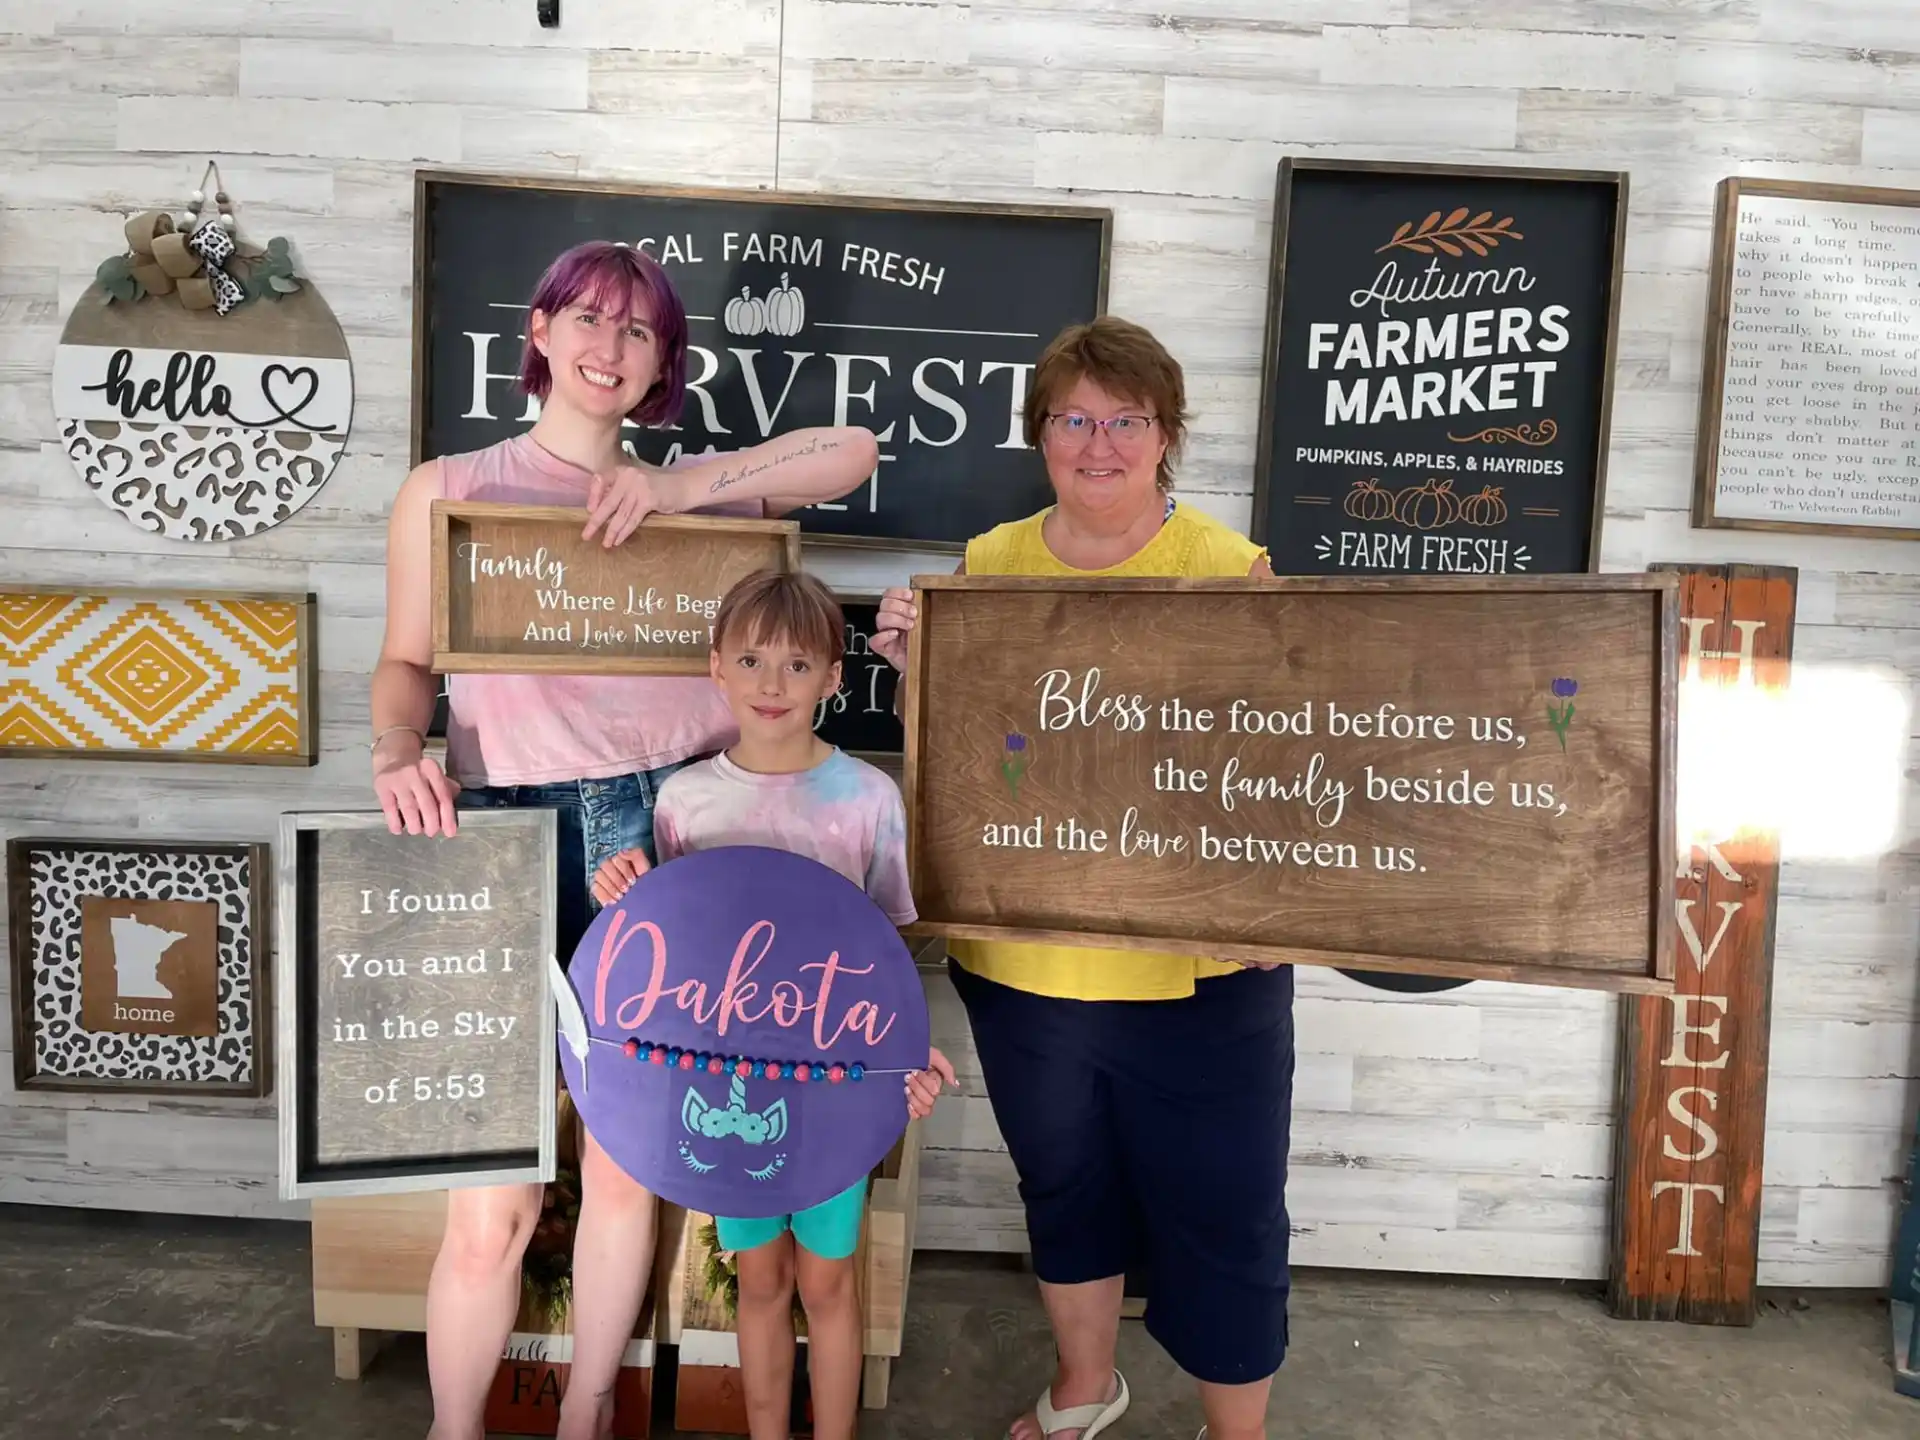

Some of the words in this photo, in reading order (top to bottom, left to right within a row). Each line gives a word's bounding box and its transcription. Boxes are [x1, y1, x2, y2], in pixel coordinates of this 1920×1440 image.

[1741, 212, 1762, 224] He
[1739, 231, 1781, 244] takes
[1815, 235, 1847, 249] long
[1858, 240, 1896, 251] time.
[614, 233, 702, 264] CAL
[723, 233, 822, 267] FARM
[842, 244, 945, 295] FRESH
[1738, 250, 1770, 263] why
[1780, 252, 1791, 262] it
[1863, 254, 1917, 271] happen
[1350, 257, 1536, 317] Autumn
[1737, 267, 1751, 277] to
[1763, 270, 1812, 283] people
[1823, 272, 1854, 284] who
[1865, 274, 1907, 288] break
[1735, 287, 1751, 296] or
[1760, 286, 1796, 297] have
[1804, 289, 1848, 304] sharp
[1734, 304, 1771, 315] have
[1785, 307, 1800, 317] to
[1814, 308, 1831, 319] be
[1845, 310, 1911, 324] carefully
[1308, 305, 1571, 370] FARMERS
[1823, 327, 1841, 338] by
[1852, 328, 1876, 340] the
[1731, 341, 1758, 351] you
[1767, 343, 1793, 352] are
[1861, 347, 1897, 358] most
[1904, 348, 1920, 360] of
[1730, 356, 1763, 368] hair
[1781, 359, 1808, 371] has
[1826, 362, 1861, 374] been
[1880, 364, 1917, 378] loved
[81, 348, 233, 422] hello
[461, 331, 1036, 450] HRVEST
[1324, 361, 1557, 426] MARKET
[1728, 375, 1757, 386] and
[1766, 379, 1802, 390] your
[1811, 382, 1844, 392] eyes
[1854, 381, 1888, 396] drop
[1727, 395, 1754, 405] you
[1766, 396, 1791, 406] get
[1803, 396, 1841, 408] loose
[1852, 399, 1867, 410] in
[1879, 400, 1902, 412] the
[1725, 411, 1754, 422] and
[1764, 414, 1797, 425] very
[1880, 418, 1907, 430] But
[1724, 428, 1772, 442] things
[1786, 431, 1824, 444] don't
[1837, 436, 1889, 447] matter
[1901, 439, 1915, 449] at
[1296, 448, 1387, 468] PUMPKINS,
[1392, 452, 1460, 471] APPLES,
[1466, 456, 1477, 471] &
[1483, 457, 1564, 475] HAYRIDES
[1722, 446, 1784, 459] because
[1792, 452, 1827, 462] once
[1836, 454, 1863, 465] you
[1872, 456, 1897, 466] are
[1719, 466, 1748, 477] you
[1758, 466, 1796, 478] can't
[1805, 468, 1823, 480] be
[1878, 475, 1919, 488] excep
[1719, 483, 1770, 496] people
[1773, 484, 1804, 497] who
[1808, 485, 1844, 499] don't
[1769, 500, 1794, 511] The
[1799, 501, 1858, 515] Velveteen
[1862, 504, 1901, 517] Rabbit
[457, 542, 568, 589] Family
[1338, 531, 1412, 569] FARM
[1421, 535, 1508, 574] FRESH
[536, 589, 615, 611] Where
[623, 585, 667, 616] Life
[676, 594, 722, 619] Begi
[523, 621, 571, 642] And
[579, 618, 627, 649] Love
[634, 623, 702, 644] Never
[1034, 667, 1152, 732] Bless
[1160, 698, 1214, 732] the
[1227, 699, 1313, 736] food
[1327, 702, 1455, 740] before
[1468, 715, 1527, 749] us,
[1153, 758, 1208, 793] the
[1221, 752, 1354, 828] family
[1364, 765, 1494, 805] beside
[1509, 782, 1568, 818] us,
[982, 816, 1043, 850] and
[1055, 819, 1108, 853] the
[1120, 806, 1189, 859] love
[1199, 826, 1358, 869] between
[1372, 844, 1427, 873] us.
[360, 889, 373, 914] I
[387, 887, 493, 914] found
[336, 953, 407, 978] You
[421, 949, 487, 976] and
[501, 948, 513, 972] I
[592, 909, 896, 1050] Dakota
[113, 1002, 175, 1023] home
[333, 1018, 368, 1042] in
[382, 1015, 440, 1040] the
[454, 1011, 516, 1040] Sky
[365, 1078, 401, 1104] of
[414, 1073, 486, 1101] 5:53
[510, 1367, 562, 1406] FA
